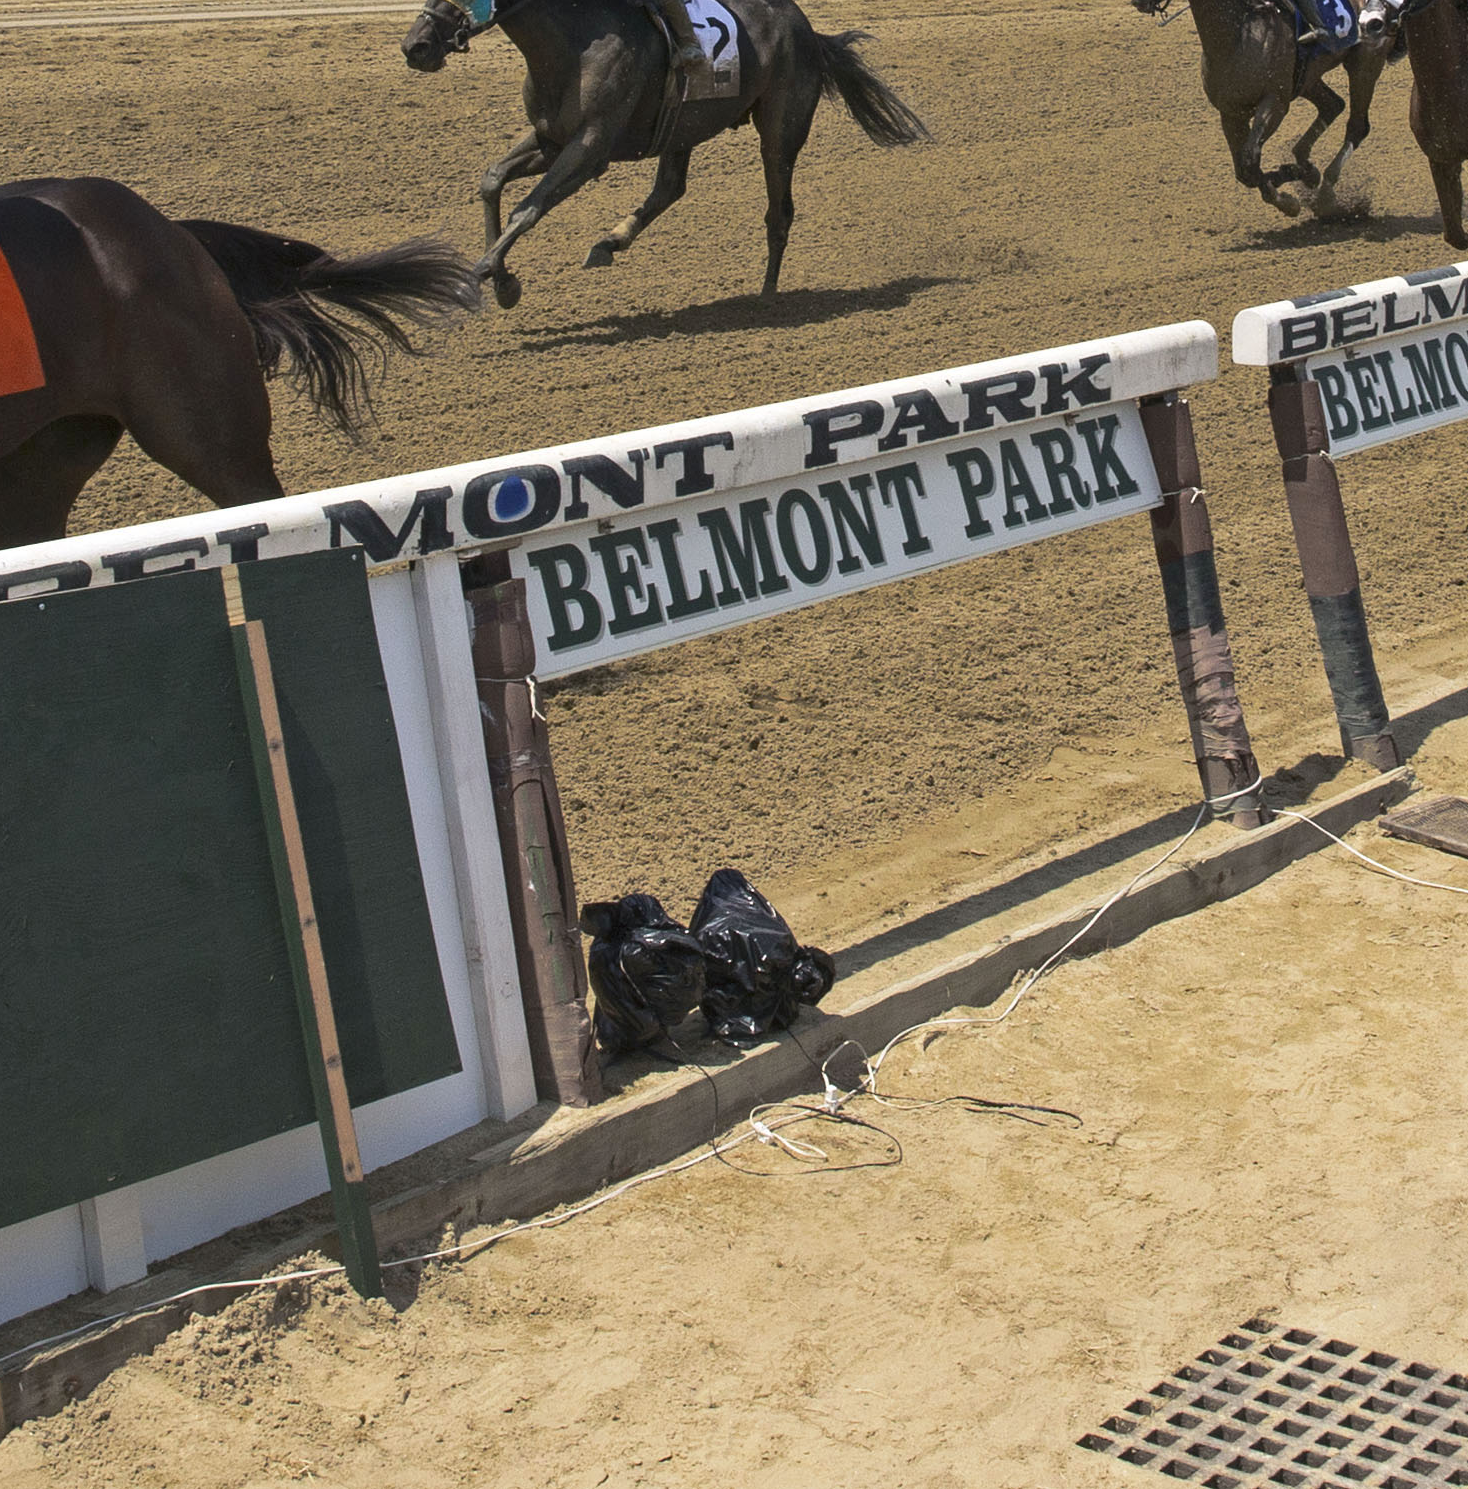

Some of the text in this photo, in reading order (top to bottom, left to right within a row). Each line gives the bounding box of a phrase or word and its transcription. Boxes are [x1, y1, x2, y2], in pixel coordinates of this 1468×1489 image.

[803, 352, 1113, 470] PARK
[526, 413, 1140, 653] BELMONT PARK
